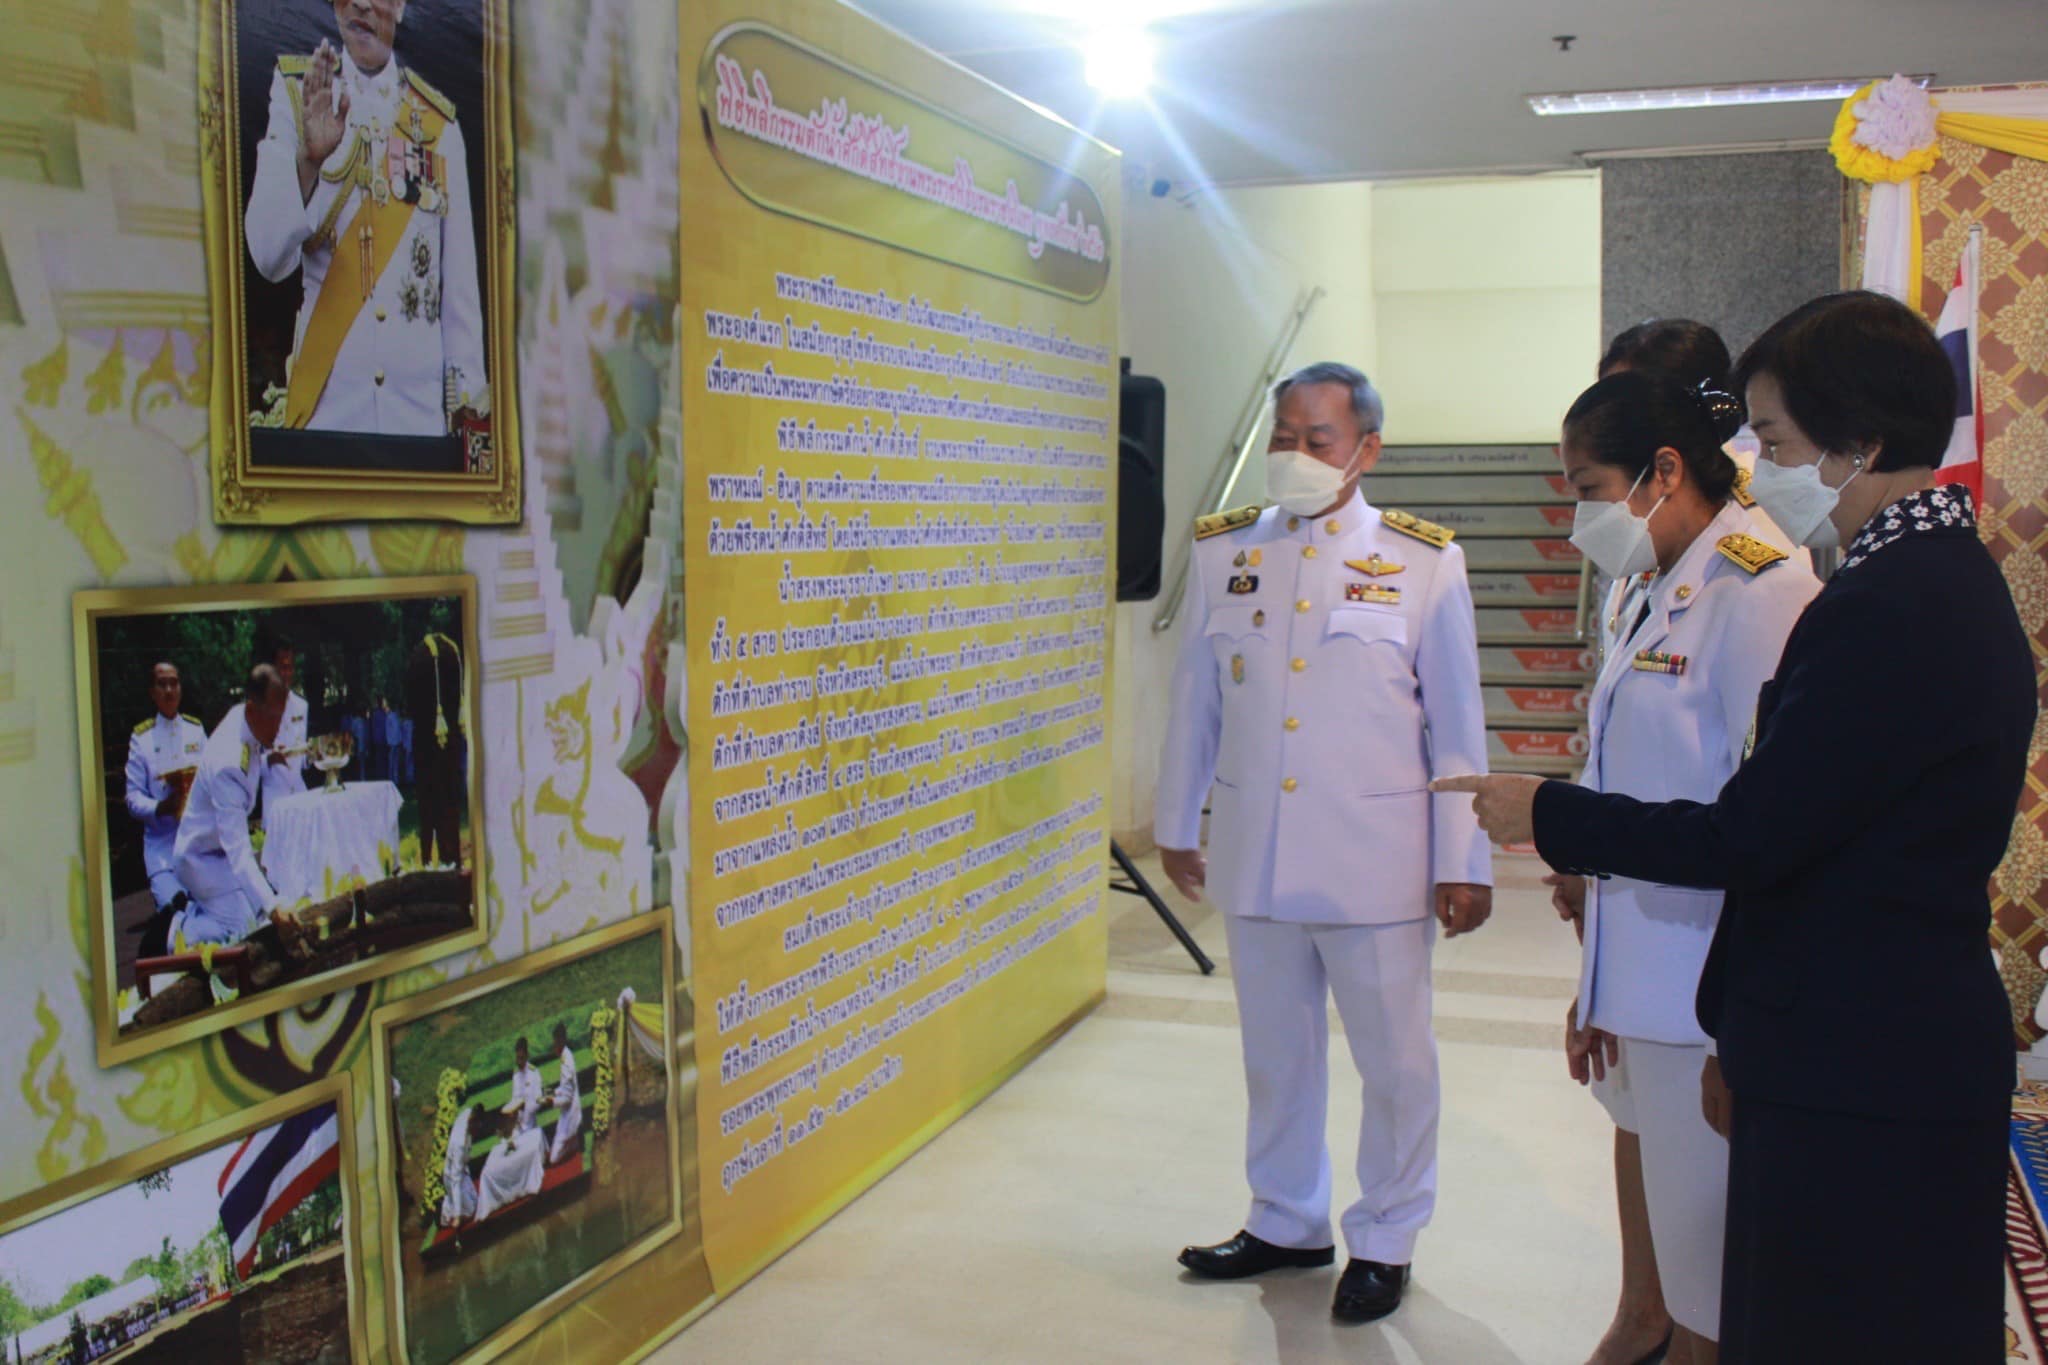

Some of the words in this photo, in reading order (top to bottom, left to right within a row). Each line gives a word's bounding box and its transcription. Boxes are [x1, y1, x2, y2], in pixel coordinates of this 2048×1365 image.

[706, 309, 783, 348] พระองค์แรก
[778, 417, 919, 459] พิธีพลีกรรมตักน้ำศักดิ์สิทธิ์
[709, 466, 764, 502] พราหมณ์
[776, 468, 803, 509] ฮินดู
[709, 508, 829, 555] ด้วยพิธีรดน้ำศักดิ์สิทธิ์
[711, 617, 731, 662] ทั้ง
[752, 631, 777, 657] สาย
[783, 603, 924, 653] ประกอบด้วยแม่น้ำบางปะกง
[713, 671, 813, 717] ตักที่ตำบลท่าราบ
[714, 713, 821, 770] ตักที่ตำบลดาวดึงส์
[715, 753, 829, 824] จากสระน้ำศักดิ์สิทธิ์
[846, 760, 865, 786] สระ
[715, 811, 798, 877] มาจากแหล่งน้ำ
[831, 802, 856, 838] แหล่ง
[859, 791, 905, 831] ทั่วประเทศ
[722, 1114, 784, 1192] ฤกษ์เวลาที่
